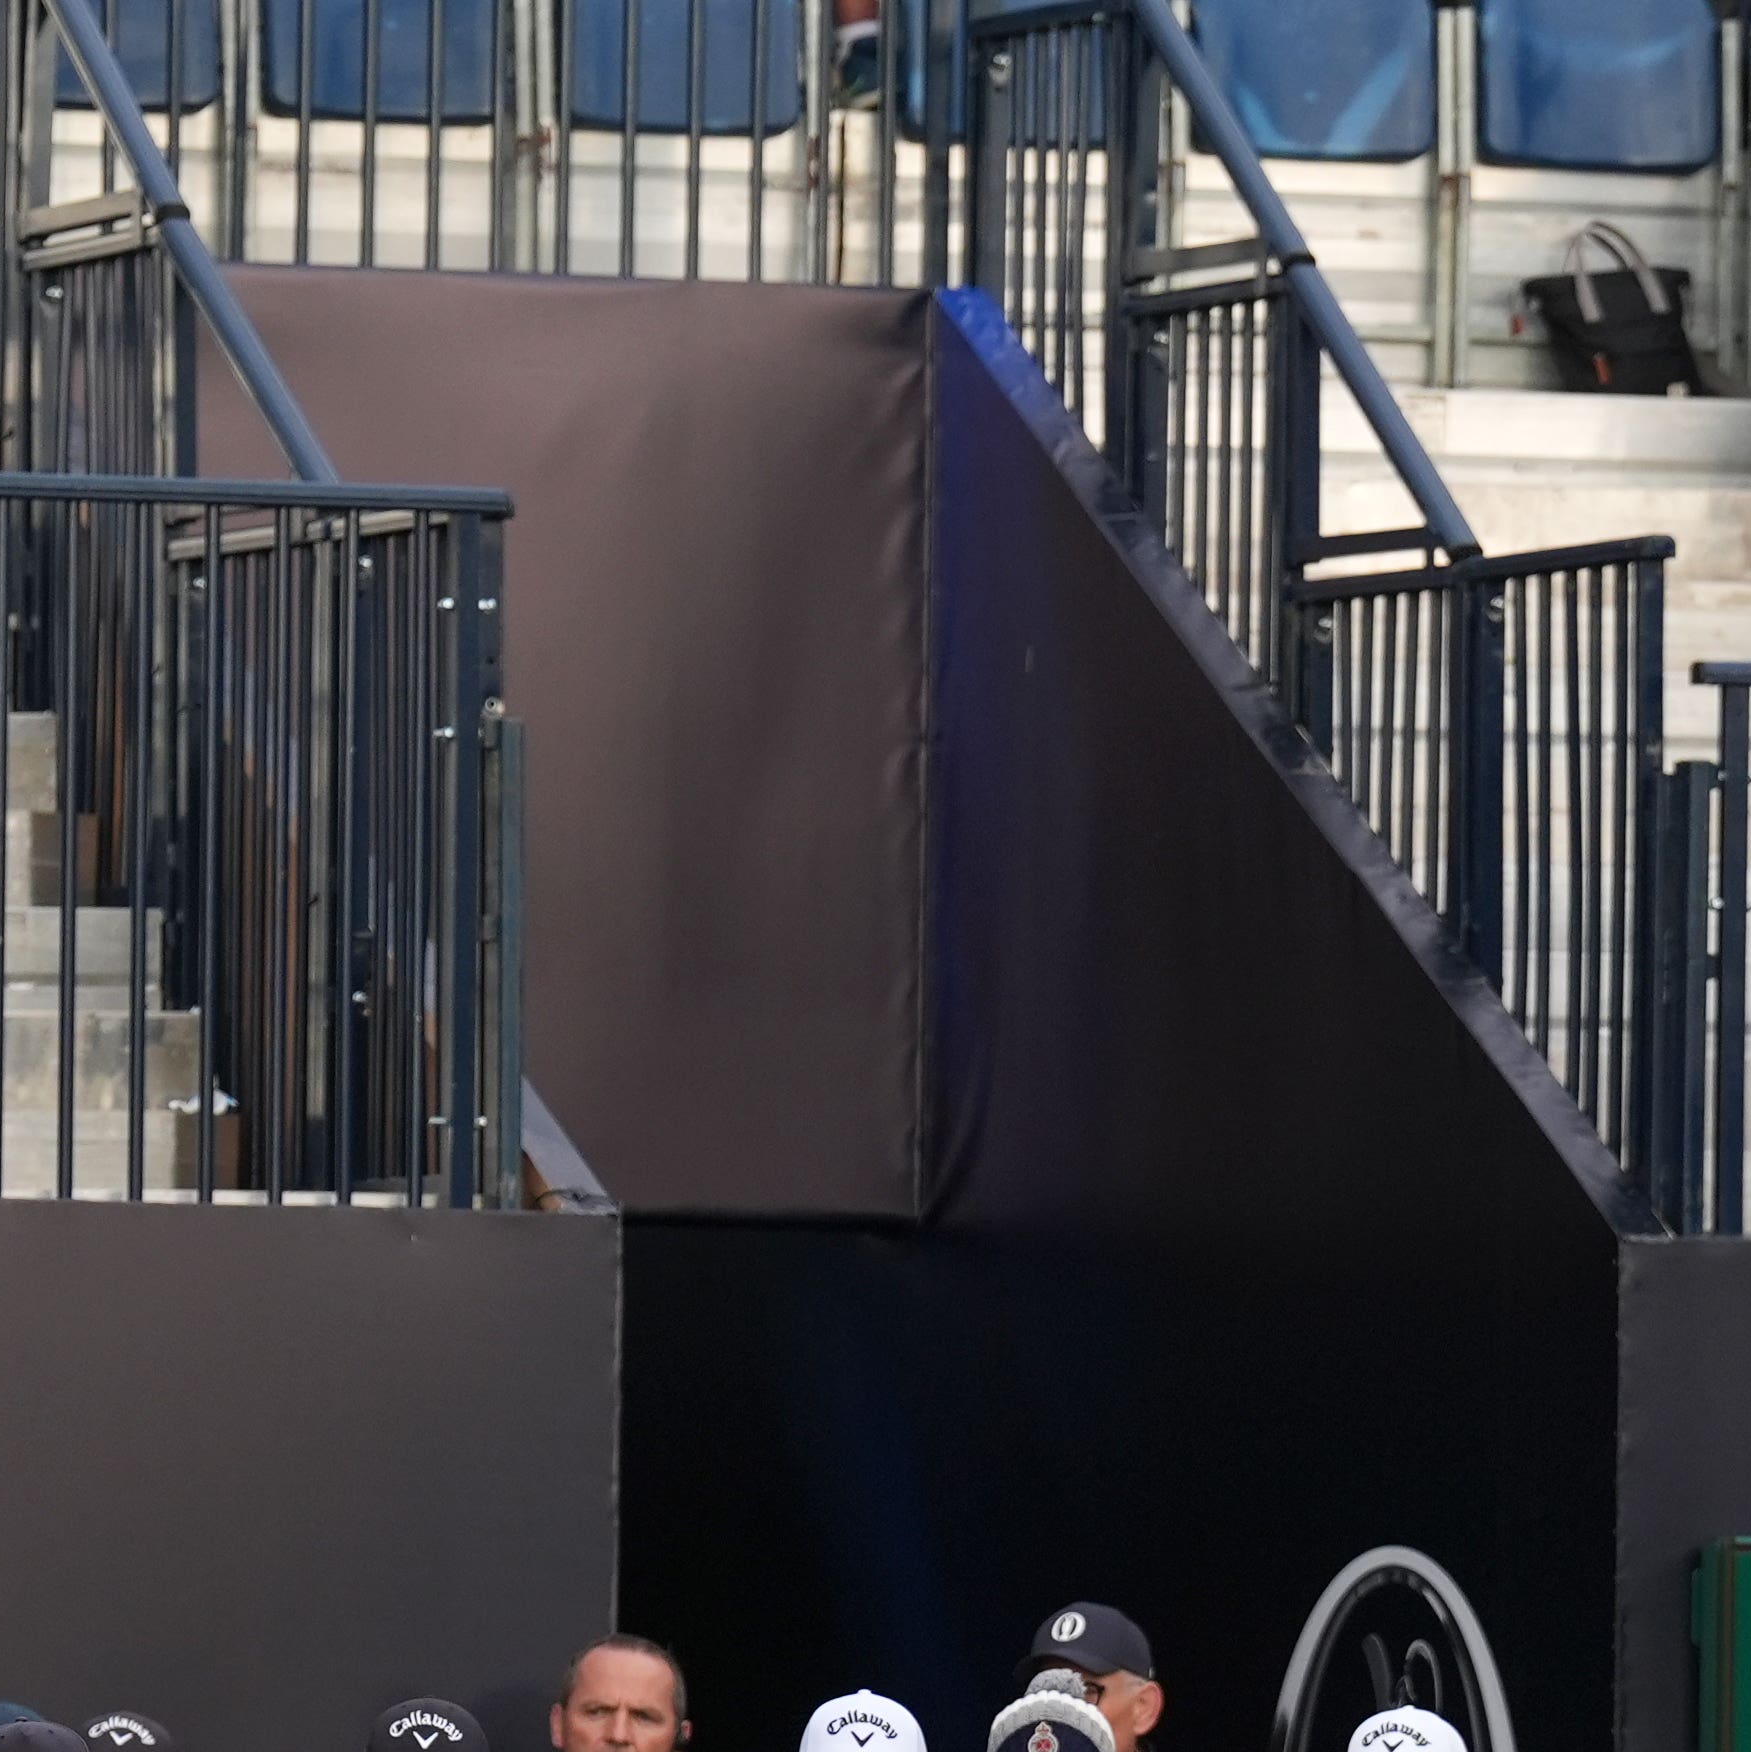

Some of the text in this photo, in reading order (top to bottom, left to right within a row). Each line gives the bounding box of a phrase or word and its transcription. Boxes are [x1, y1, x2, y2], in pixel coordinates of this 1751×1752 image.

[88, 1715, 156, 1746] Callaway
[389, 1709, 463, 1742] Callaway
[827, 1710, 898, 1740] Callaway
[1362, 1721, 1432, 1747] Callaway
